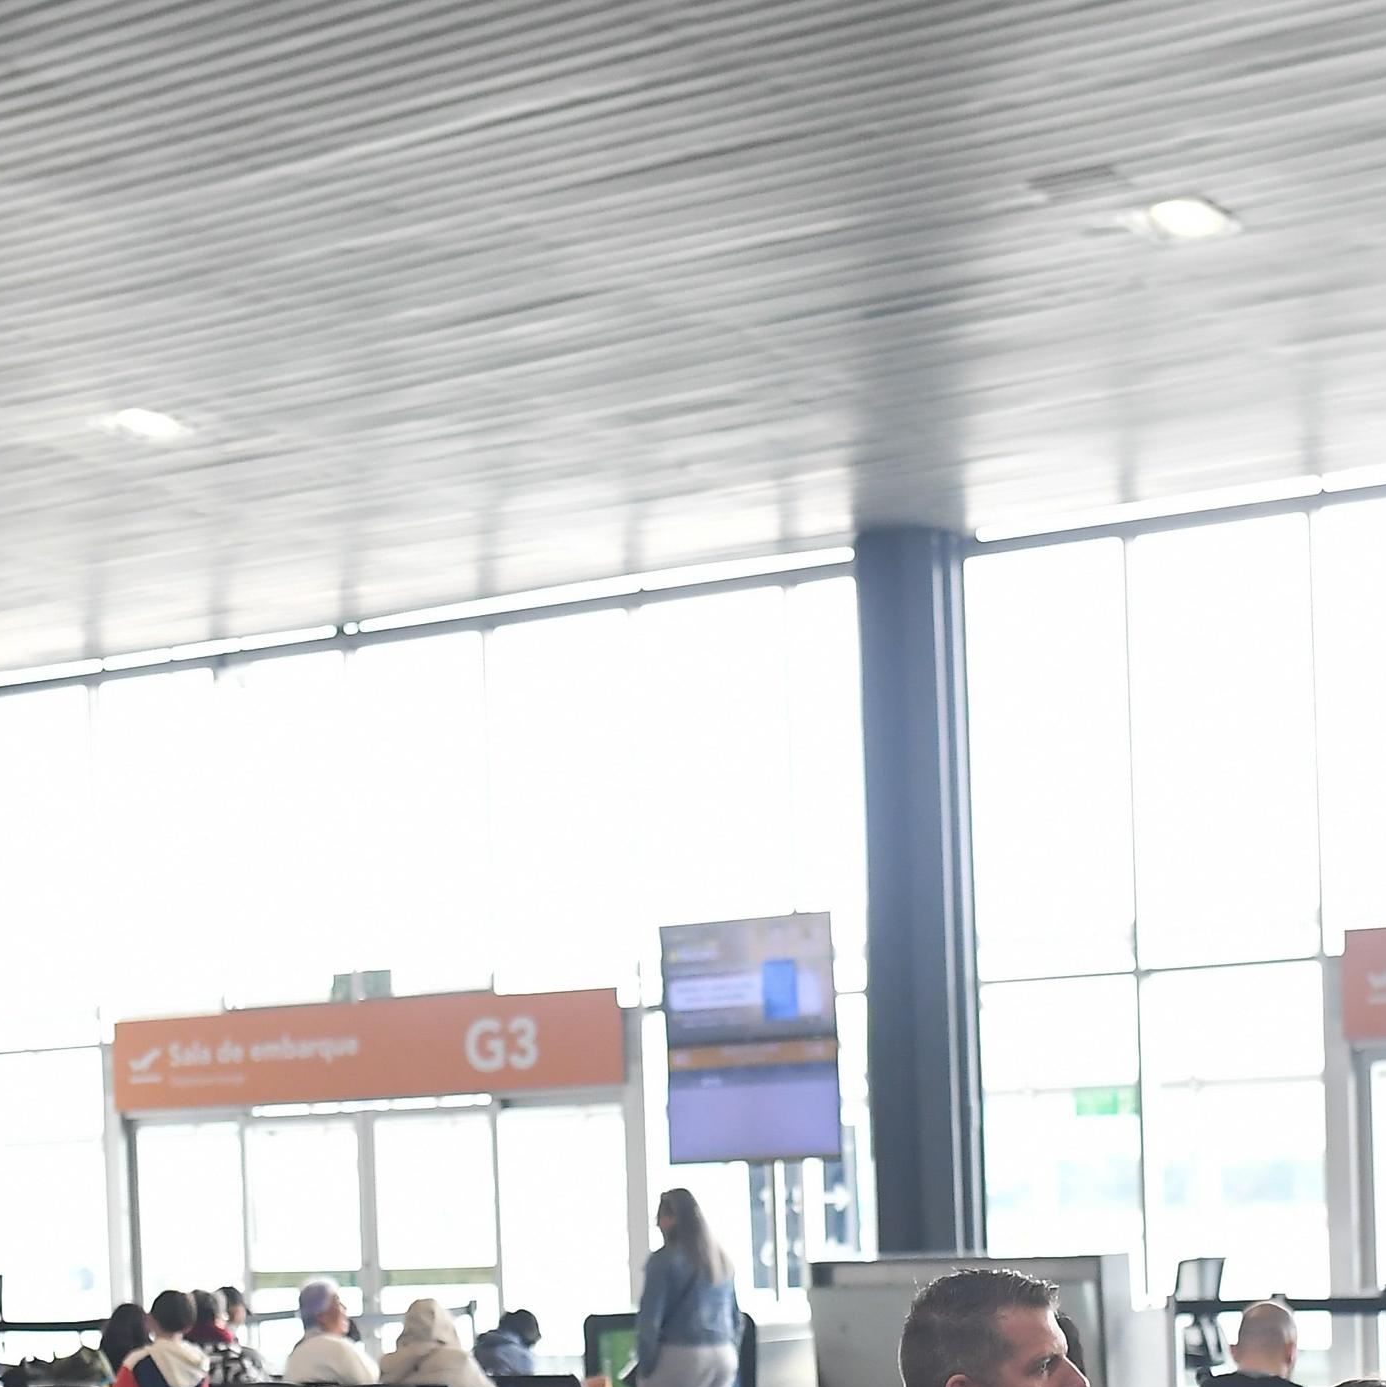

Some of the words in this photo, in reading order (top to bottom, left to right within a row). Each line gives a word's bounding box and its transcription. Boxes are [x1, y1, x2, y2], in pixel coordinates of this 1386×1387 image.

[168, 1039, 211, 1068] Sala
[216, 1036, 243, 1065] de
[249, 1033, 360, 1064] embarque
[464, 1017, 539, 1073] G3
